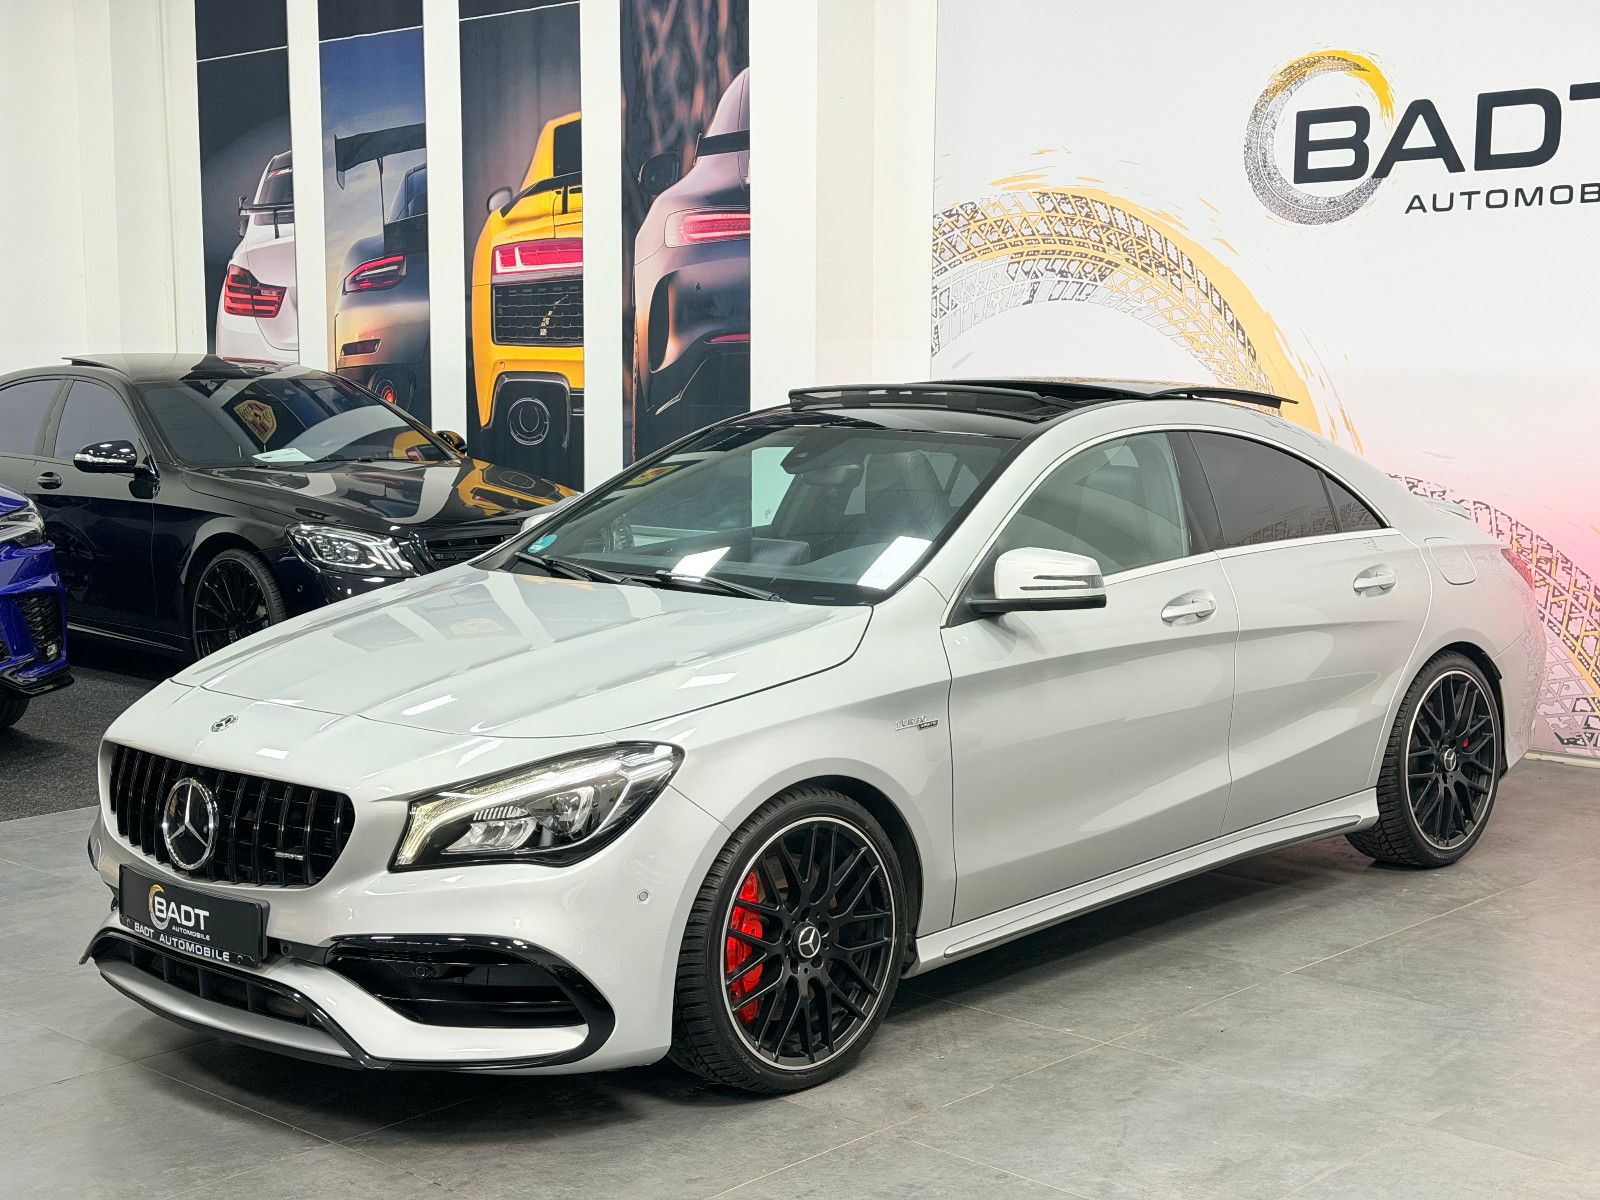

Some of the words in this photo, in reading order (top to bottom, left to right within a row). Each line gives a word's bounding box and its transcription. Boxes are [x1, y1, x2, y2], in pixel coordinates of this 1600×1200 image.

[1293, 81, 1600, 185] BAD
[1404, 183, 1600, 215] AUTOMOB
[154, 896, 210, 930] BADT
[134, 921, 155, 939] BADT
[159, 933, 230, 962] AUTOMOBILE
[171, 925, 211, 941] AUTOMOBILE
